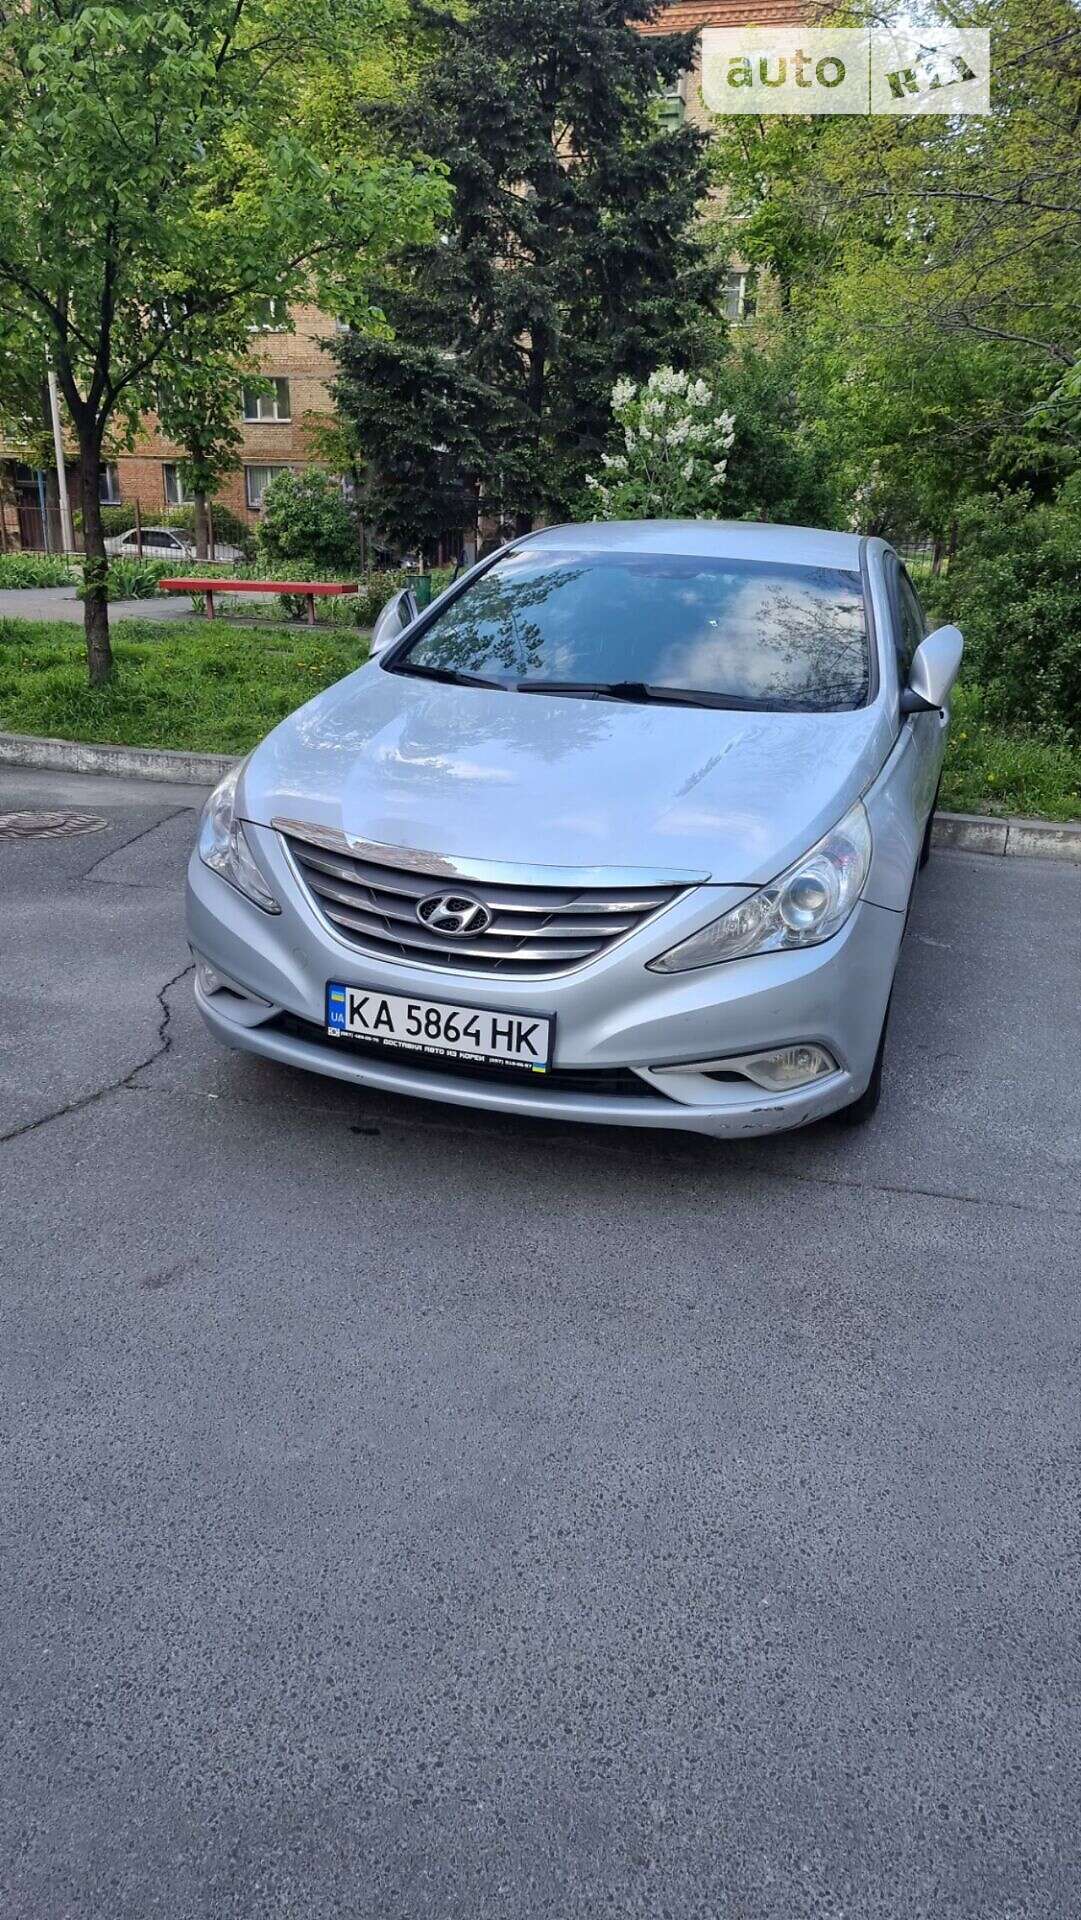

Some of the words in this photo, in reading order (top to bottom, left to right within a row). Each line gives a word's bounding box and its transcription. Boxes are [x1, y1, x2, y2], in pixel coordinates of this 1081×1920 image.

[331, 1012, 345, 1024] UA
[349, 994, 395, 1033] KA
[406, 1004, 480, 1047] 5864
[491, 1018, 540, 1056] HK
